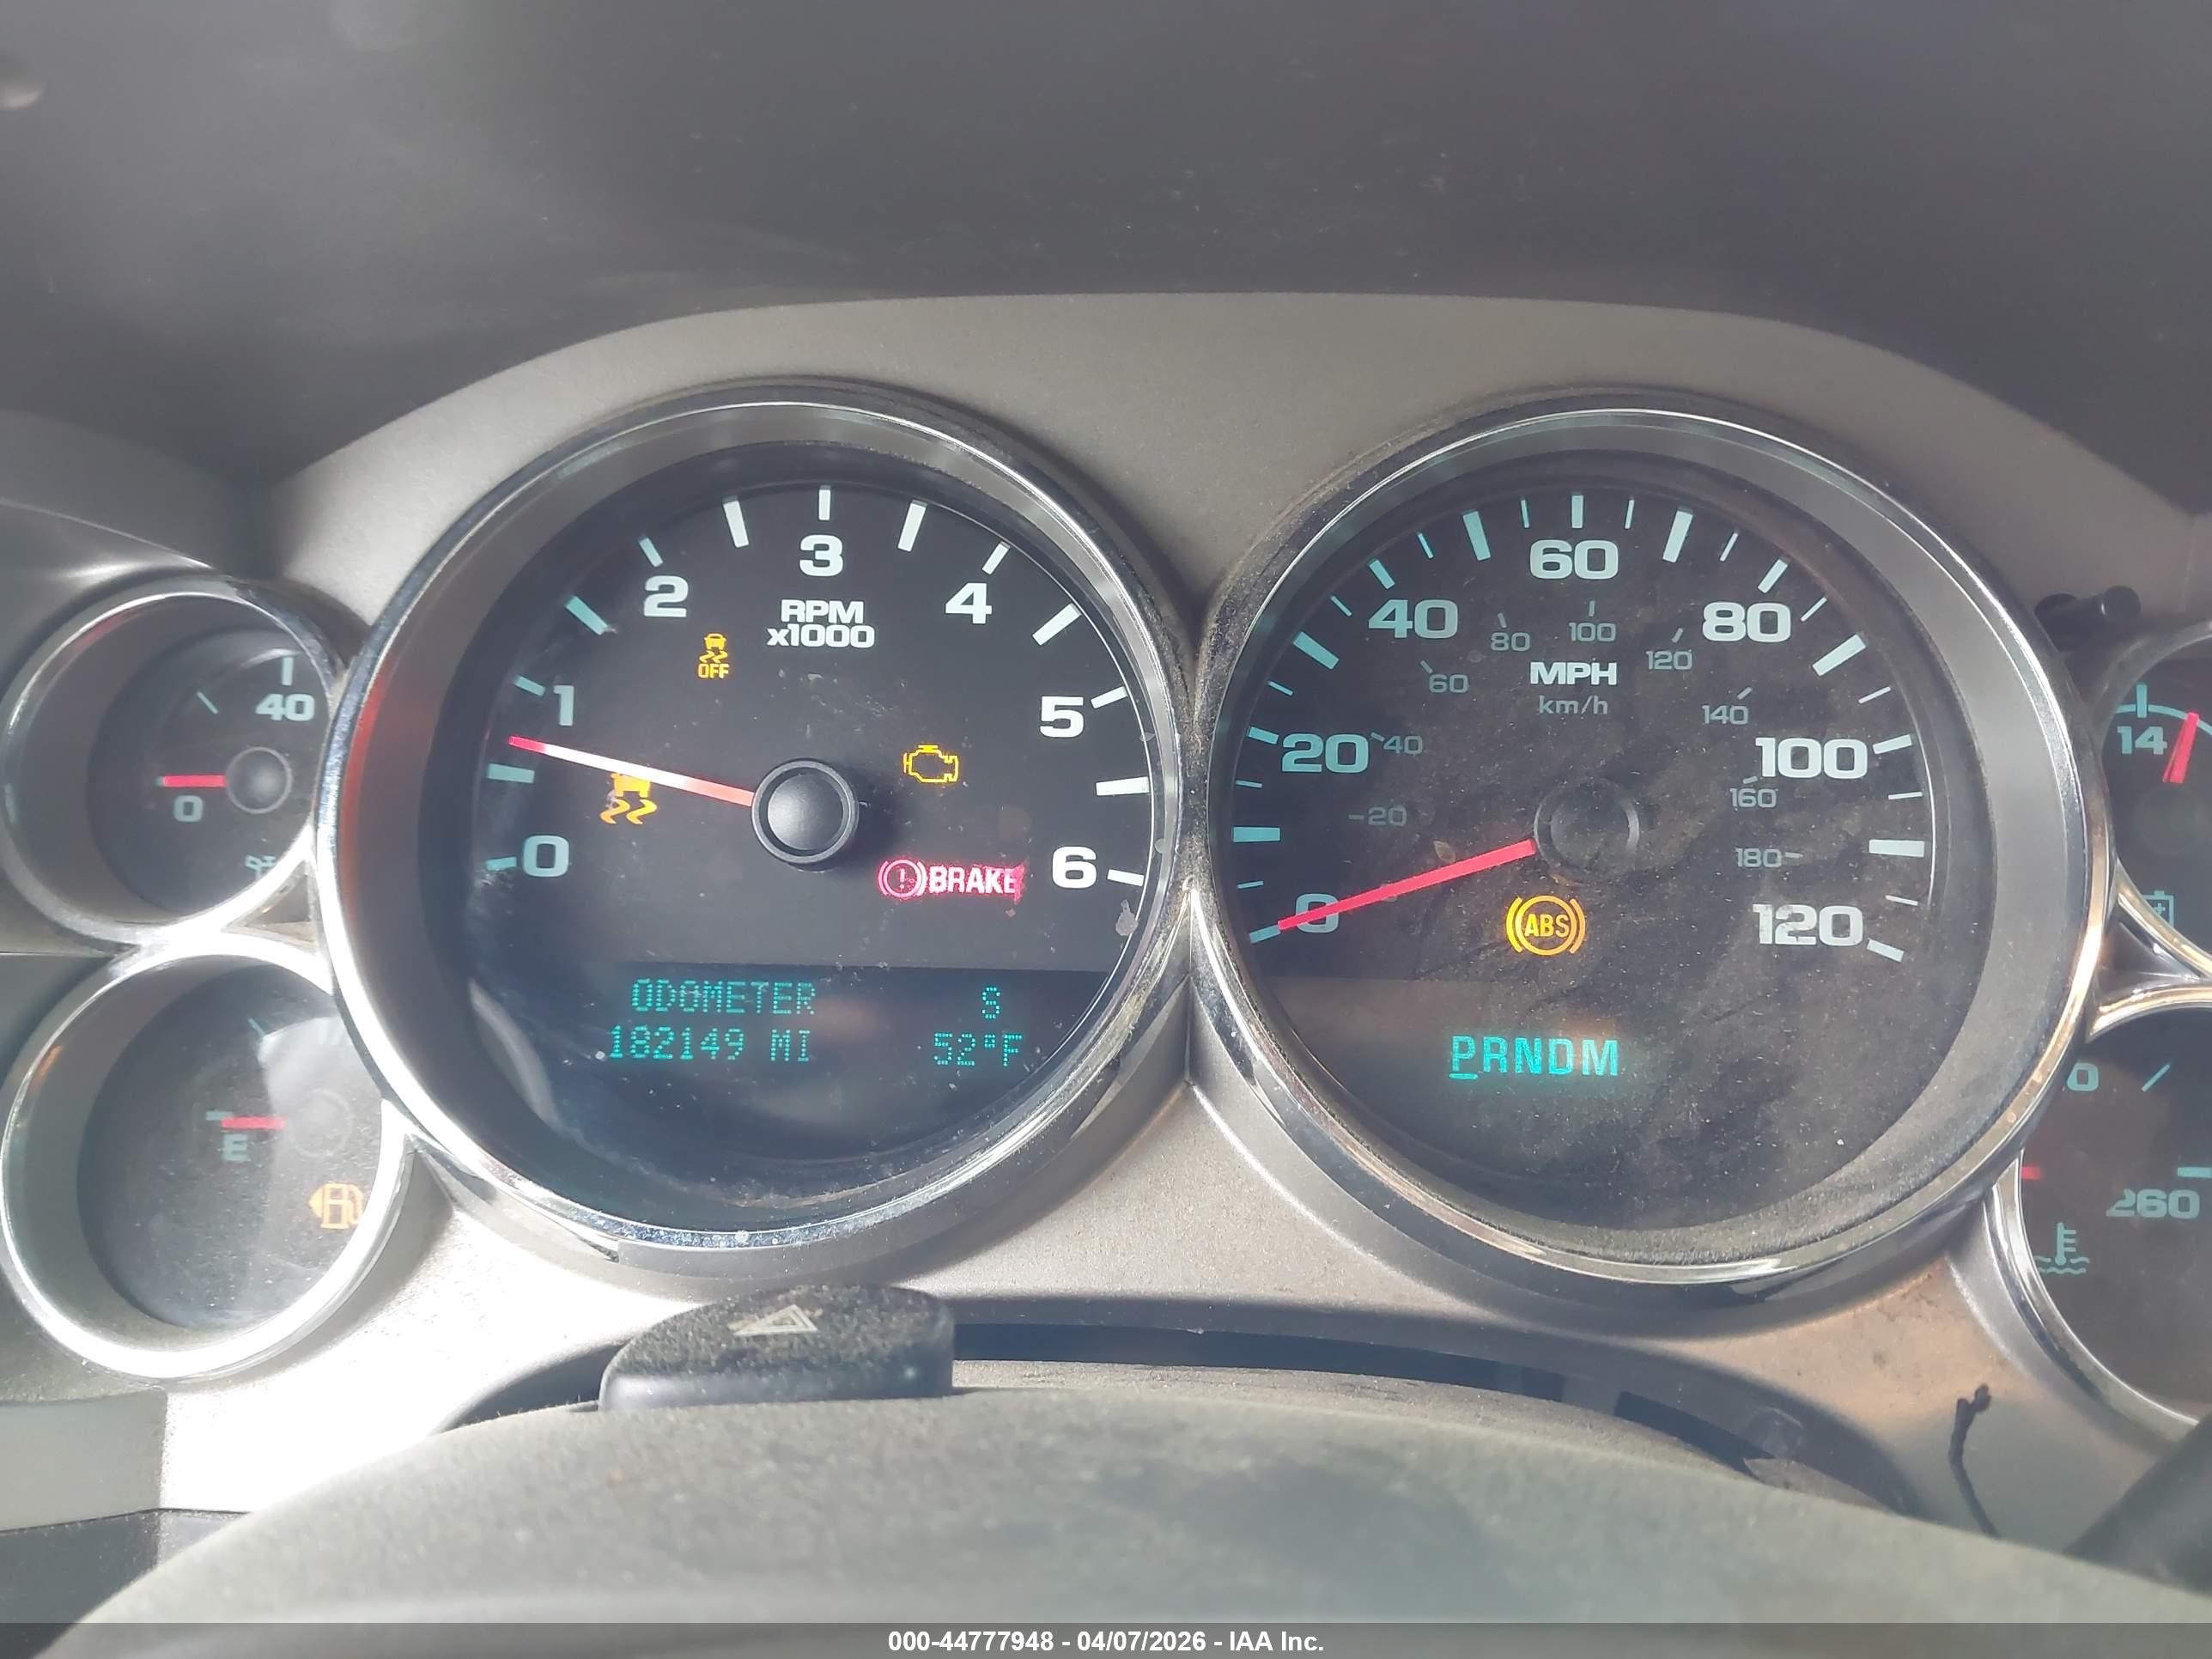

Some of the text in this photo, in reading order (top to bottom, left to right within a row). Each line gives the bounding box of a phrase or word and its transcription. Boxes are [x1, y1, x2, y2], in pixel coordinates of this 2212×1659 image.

[799, 534, 844, 577] 3
[1529, 539, 1620, 580] 60
[642, 575, 688, 618] 2
[945, 582, 993, 624] 4
[781, 599, 864, 624] RPM
[1368, 599, 1459, 639] 40
[1702, 602, 1791, 642] 80
[767, 623, 875, 649] x1000
[1490, 632, 1531, 652] 80
[1569, 623, 1617, 642] 100
[697, 662, 730, 679] OFF
[1530, 662, 1618, 685] MPH
[1645, 650, 1692, 671] 120
[1428, 674, 1469, 694] 60
[256, 694, 315, 721] 40
[554, 684, 574, 726] 1
[1040, 696, 1085, 738] 5
[1538, 696, 1608, 715] km/h
[1702, 705, 1748, 726] 140
[1282, 733, 1369, 773] 20
[1382, 735, 1423, 756] 40
[2117, 726, 2167, 755] 14
[1755, 738, 1868, 779] 100
[173, 796, 204, 823] 0
[1730, 787, 1778, 809] 160
[1367, 805, 1407, 826] 20
[522, 836, 569, 878] 0
[1052, 847, 1097, 890] 6
[1735, 848, 1782, 869] 180
[928, 865, 1020, 895] BRAKE
[1295, 893, 1340, 933] 0
[1753, 904, 1863, 945] 120
[1524, 917, 1570, 939] ABS
[631, 978, 1001, 1019] ODOMETER S
[609, 1024, 1022, 1066] 182149 MI 52°F
[1450, 1035, 1619, 1077] PRNDM
[222, 1133, 249, 1162] E
[2106, 1188, 2200, 1219] 260
